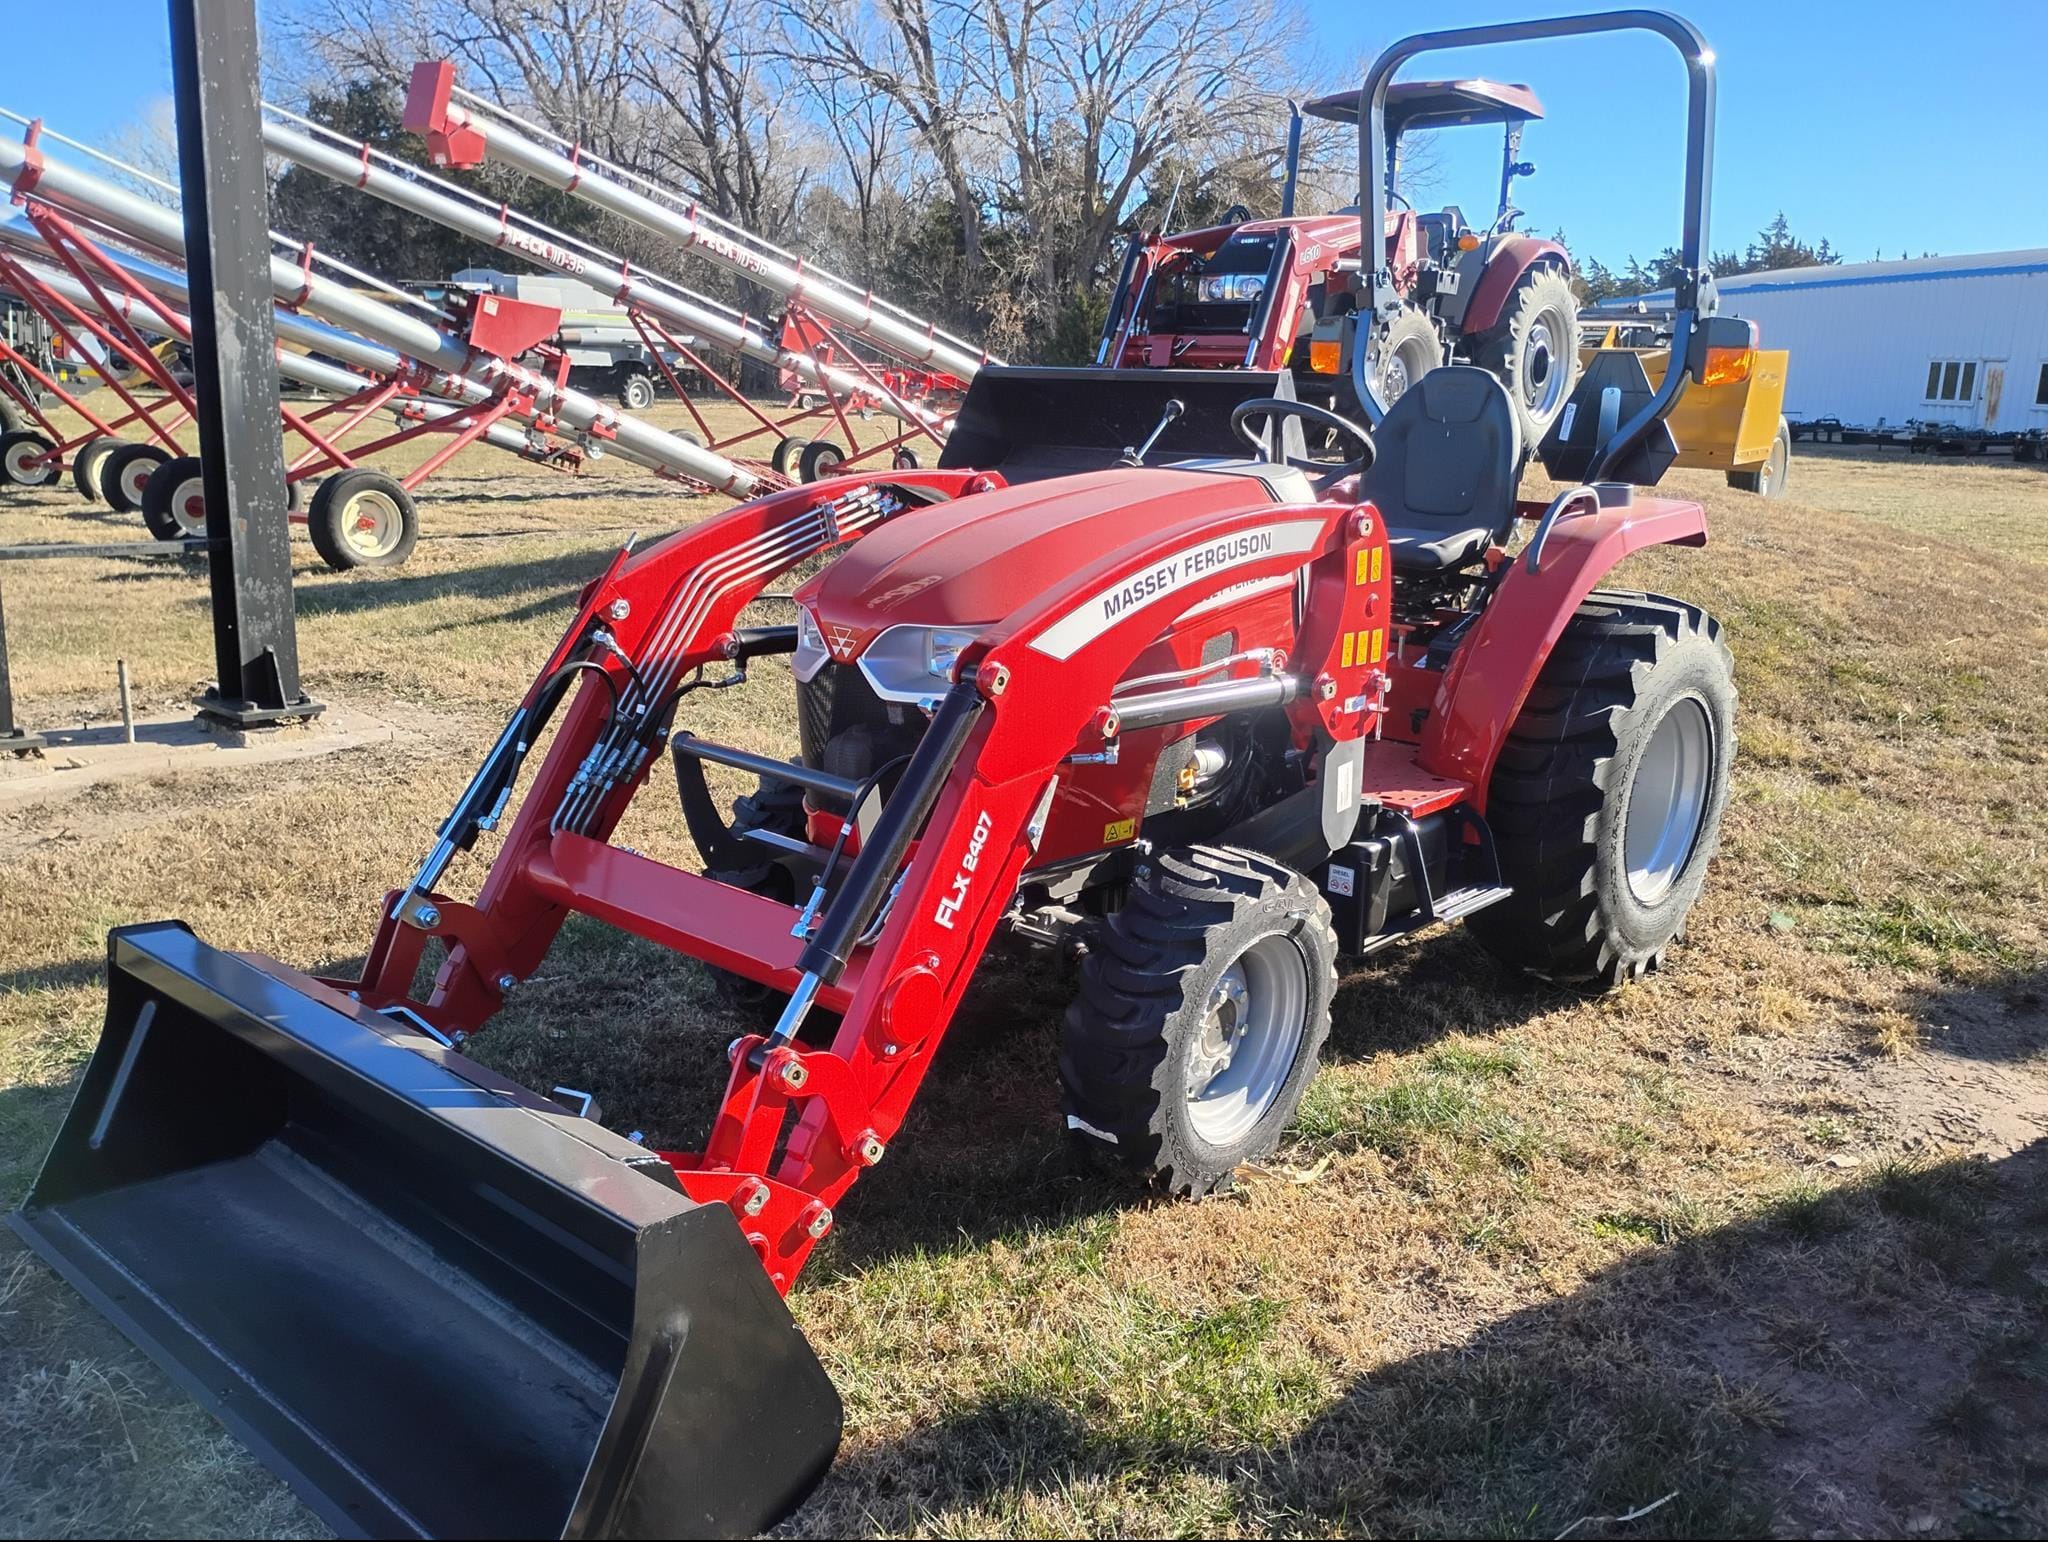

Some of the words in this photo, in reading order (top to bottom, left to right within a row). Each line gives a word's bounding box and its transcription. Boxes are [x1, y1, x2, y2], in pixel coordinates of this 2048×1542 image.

[511, 230, 549, 258] PECK
[697, 231, 735, 259] PECK
[1300, 245, 1320, 264] L610
[1103, 562, 1178, 620] MASSEY
[1184, 531, 1272, 577] FERGUSON
[934, 871, 971, 930] FLX
[961, 809, 992, 872] 2407
